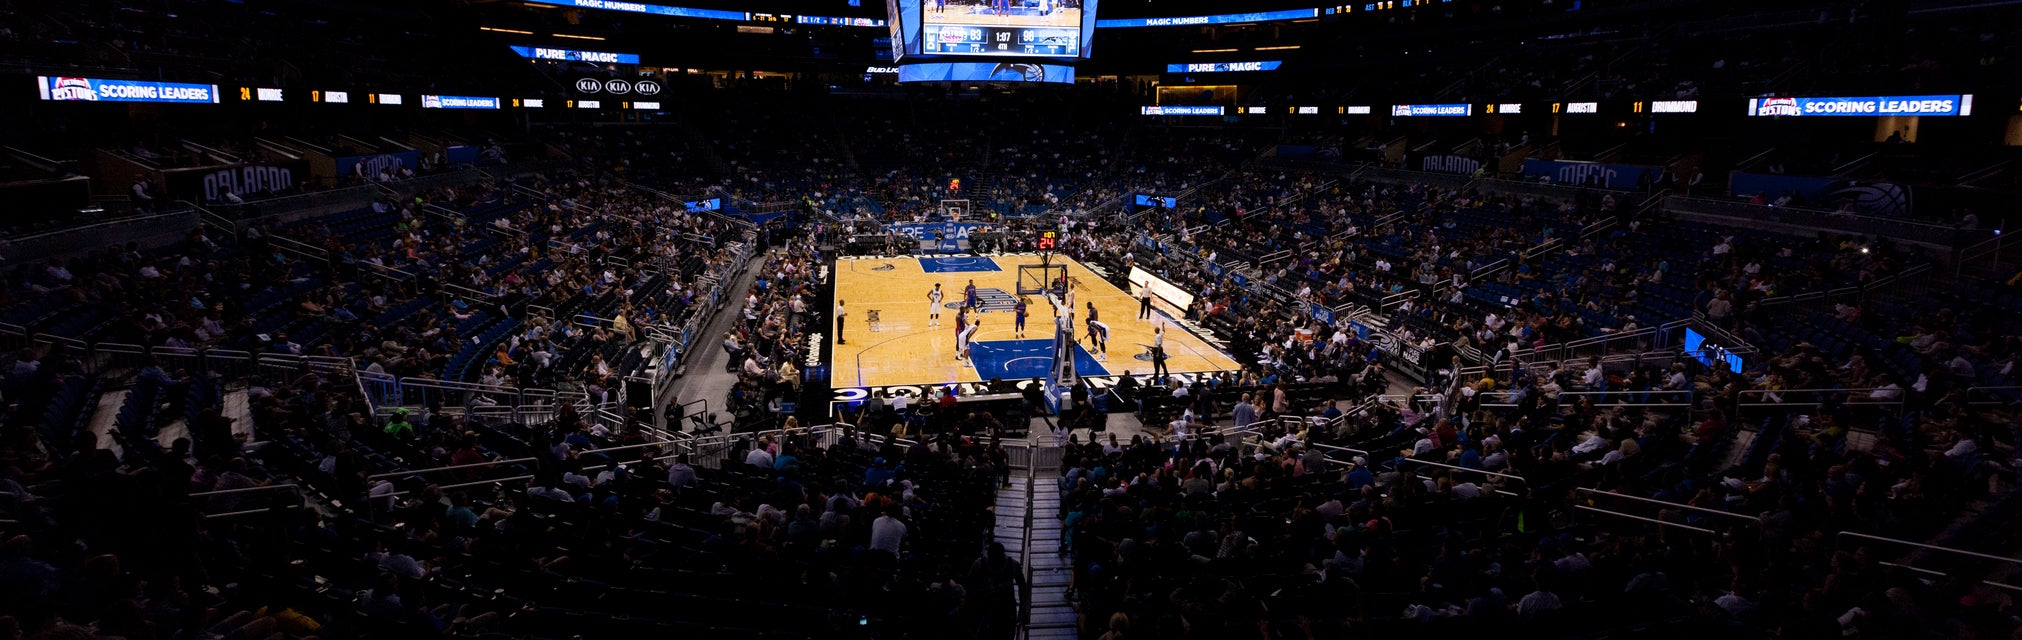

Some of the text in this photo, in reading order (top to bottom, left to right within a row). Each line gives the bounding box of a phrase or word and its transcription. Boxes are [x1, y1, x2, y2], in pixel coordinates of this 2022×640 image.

[604, 1, 646, 12] NUMBERS
[1172, 16, 1209, 24] NUMBERS
[970, 29, 982, 41] 83
[996, 31, 1011, 42] 1:07
[1023, 30, 1034, 42] 96
[535, 48, 618, 62] PURE MAGIC
[1188, 62, 1261, 73] PURE MAGIC
[580, 79, 598, 91] KIA
[609, 80, 627, 92] KIA
[638, 82, 657, 93] KIA
[99, 84, 209, 100] SCORING LEADERS
[240, 87, 250, 101] 24
[312, 90, 319, 102] 17
[369, 93, 375, 104] 11
[441, 98, 494, 107] SCORING LEADERS
[567, 100, 573, 108] 17
[623, 101, 628, 109] 11
[1238, 106, 1244, 114] 24
[1338, 106, 1344, 114] 11
[1412, 106, 1465, 115] SCORING LEADERS
[1486, 104, 1494, 114] 24
[1552, 103, 1560, 113] 17
[1567, 102, 1597, 113] AUGUSTIN
[1633, 102, 1643, 113] 11
[1652, 101, 1697, 113] DRUMMOND
[1804, 100, 1953, 114] SCORING LEADERS
[1040, 238, 1054, 249] 24
